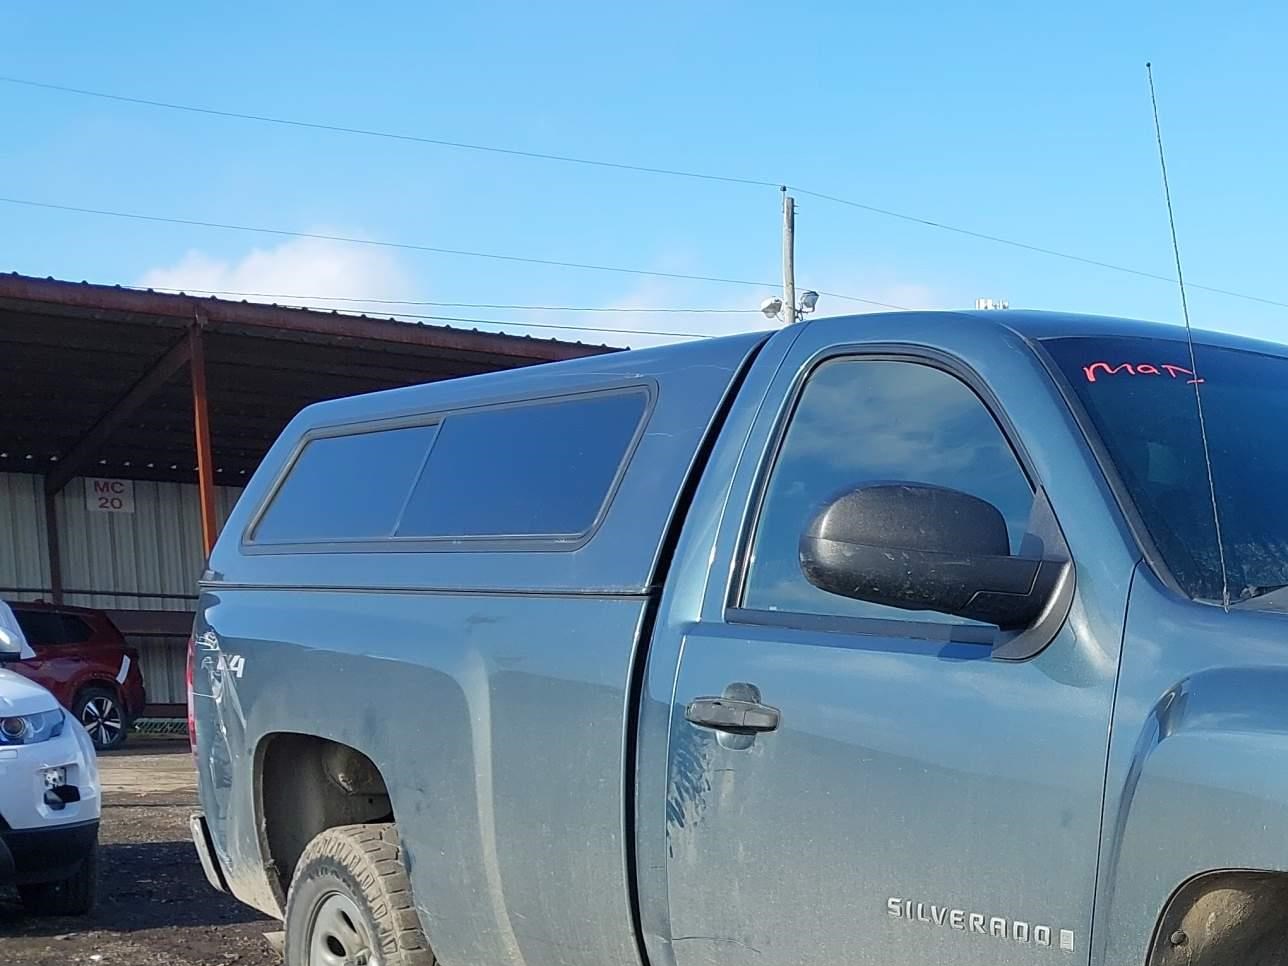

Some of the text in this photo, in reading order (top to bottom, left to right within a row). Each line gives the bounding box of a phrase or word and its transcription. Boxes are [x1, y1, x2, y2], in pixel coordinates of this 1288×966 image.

[94, 480, 125, 494] MC
[98, 497, 123, 510] 20
[887, 896, 1052, 948] SILVERADO
